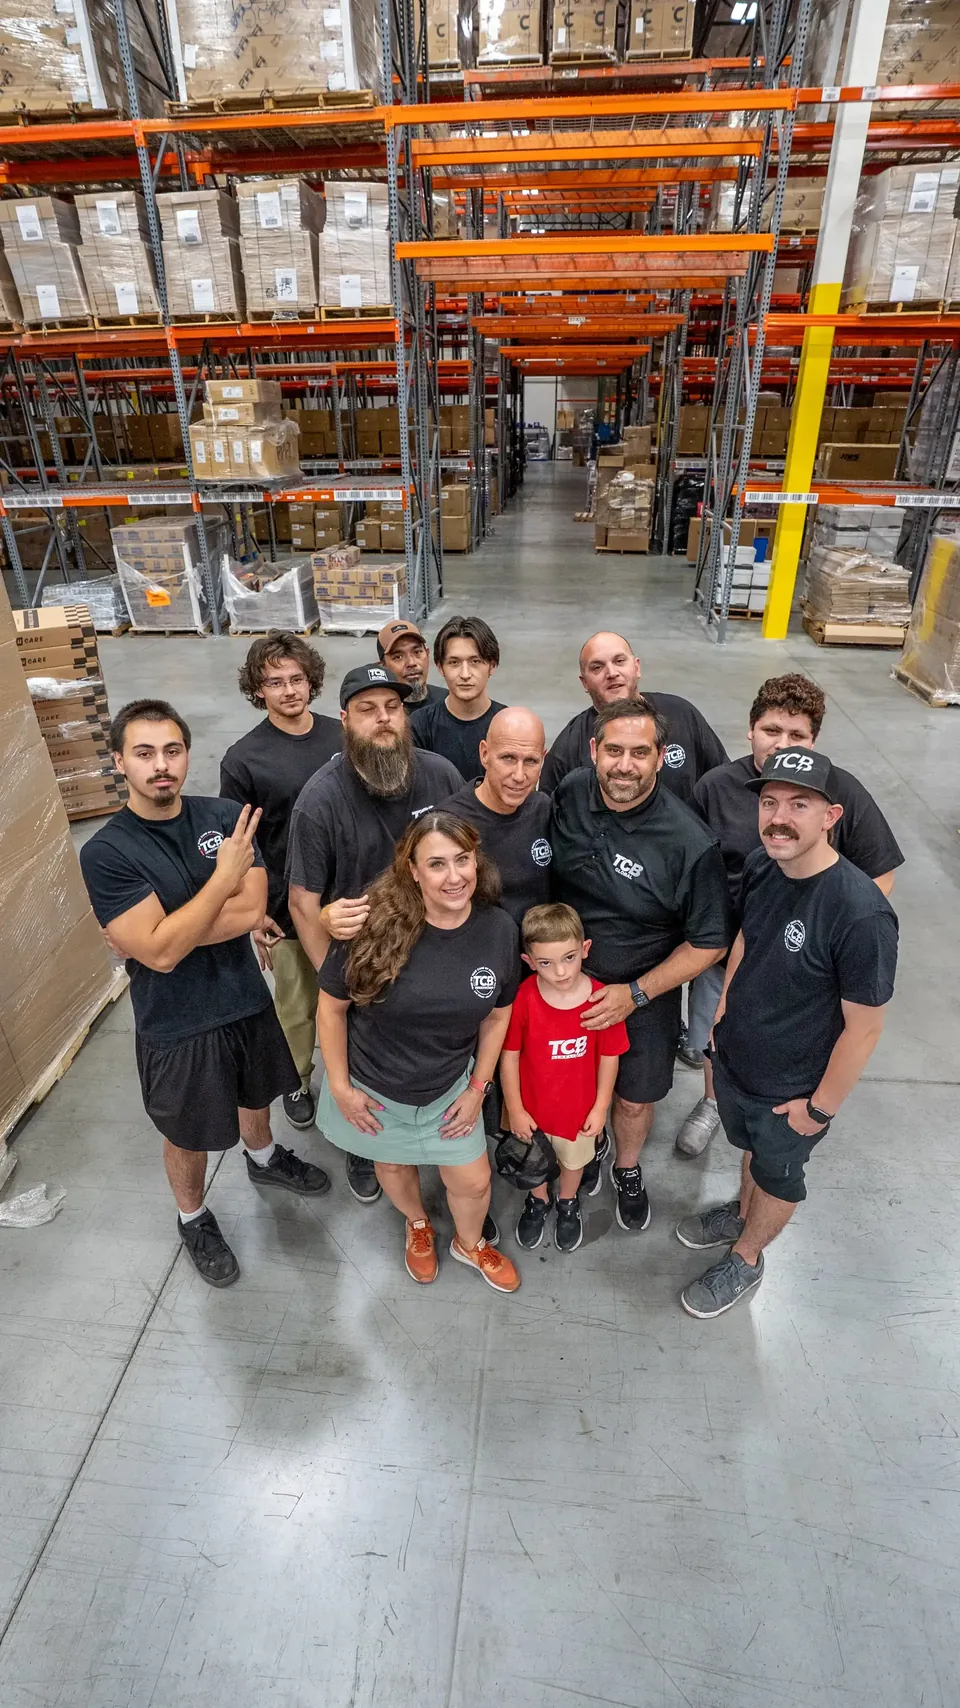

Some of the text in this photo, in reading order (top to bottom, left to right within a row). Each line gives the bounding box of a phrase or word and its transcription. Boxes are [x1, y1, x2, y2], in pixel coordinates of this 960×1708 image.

[24, 636, 44, 644] CARE
[27, 656, 47, 664] CARE
[53, 749, 70, 757] CARE
[665, 749, 683, 761] TCB
[772, 753, 815, 774] TCB
[200, 835, 223, 851] TCB
[534, 845, 550, 857] TCB
[613, 853, 644, 877] TCB
[788, 924, 804, 944] TCB
[473, 975, 494, 987] TCB
[548, 1035, 588, 1056] TCB
